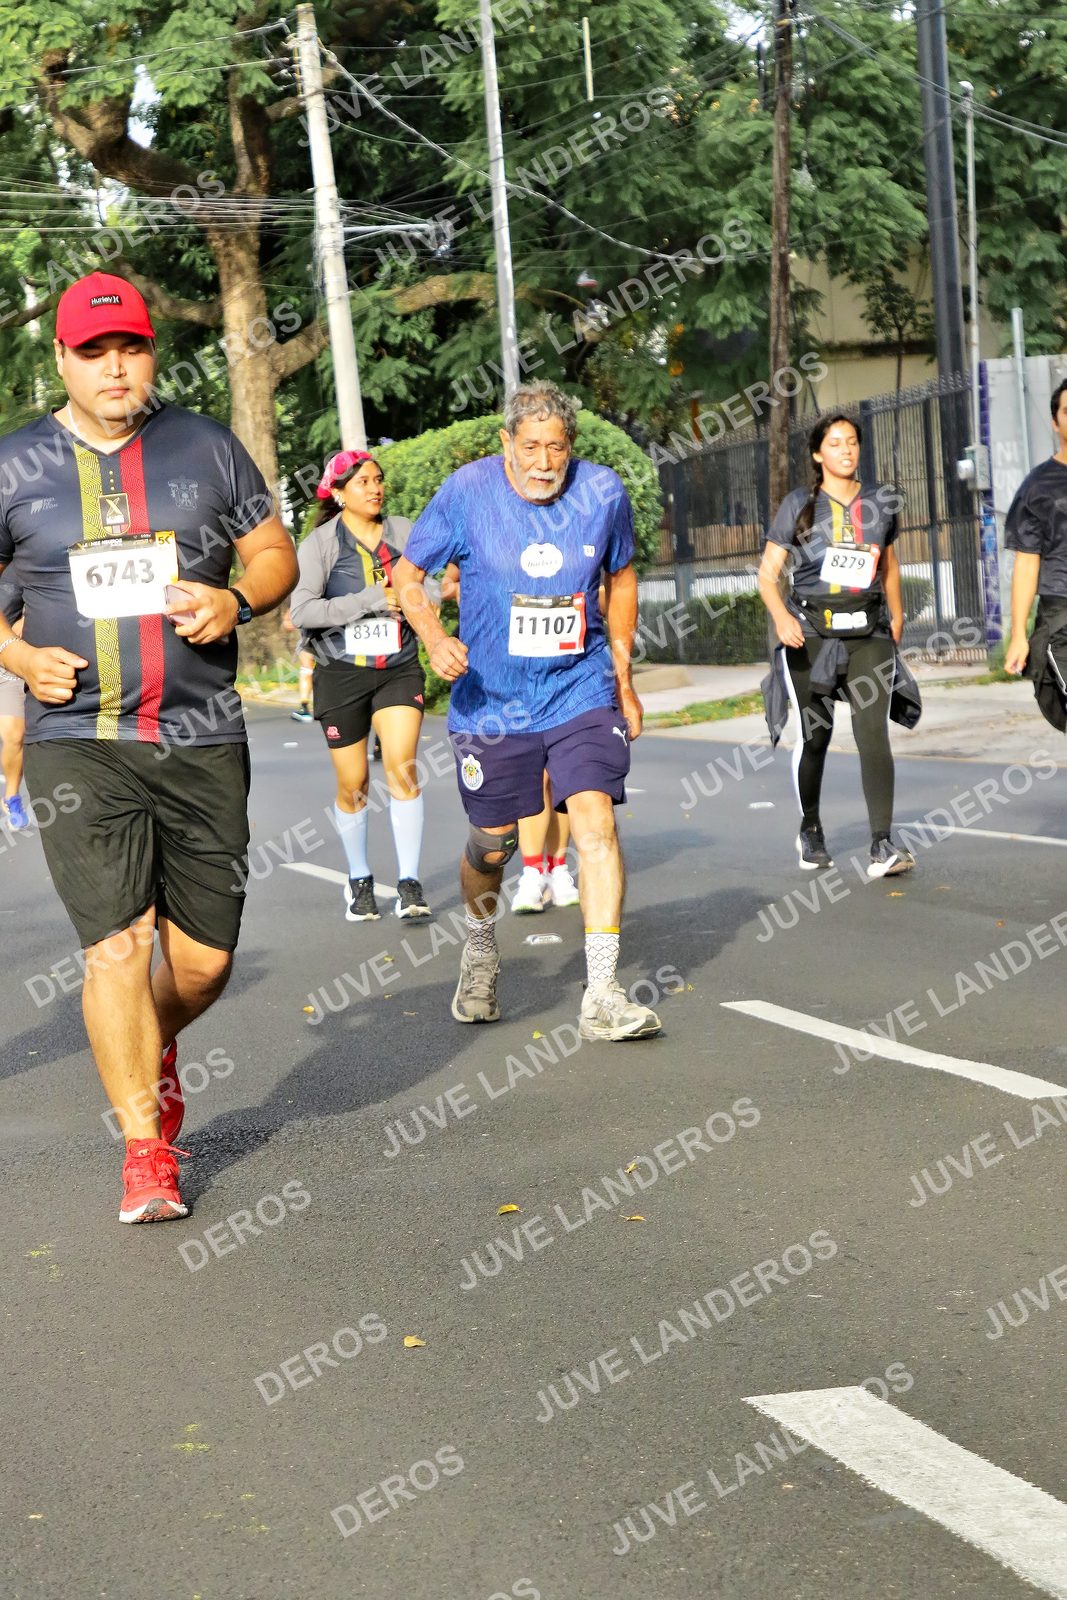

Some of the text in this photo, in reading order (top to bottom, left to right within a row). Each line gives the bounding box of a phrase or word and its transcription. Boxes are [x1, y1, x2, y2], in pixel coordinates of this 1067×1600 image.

[91, 296, 113, 305] Hurley
[831, 554, 866, 570] 8279
[86, 559, 155, 588] 6743
[353, 623, 388, 639] 8341
[516, 615, 576, 635] 11107
